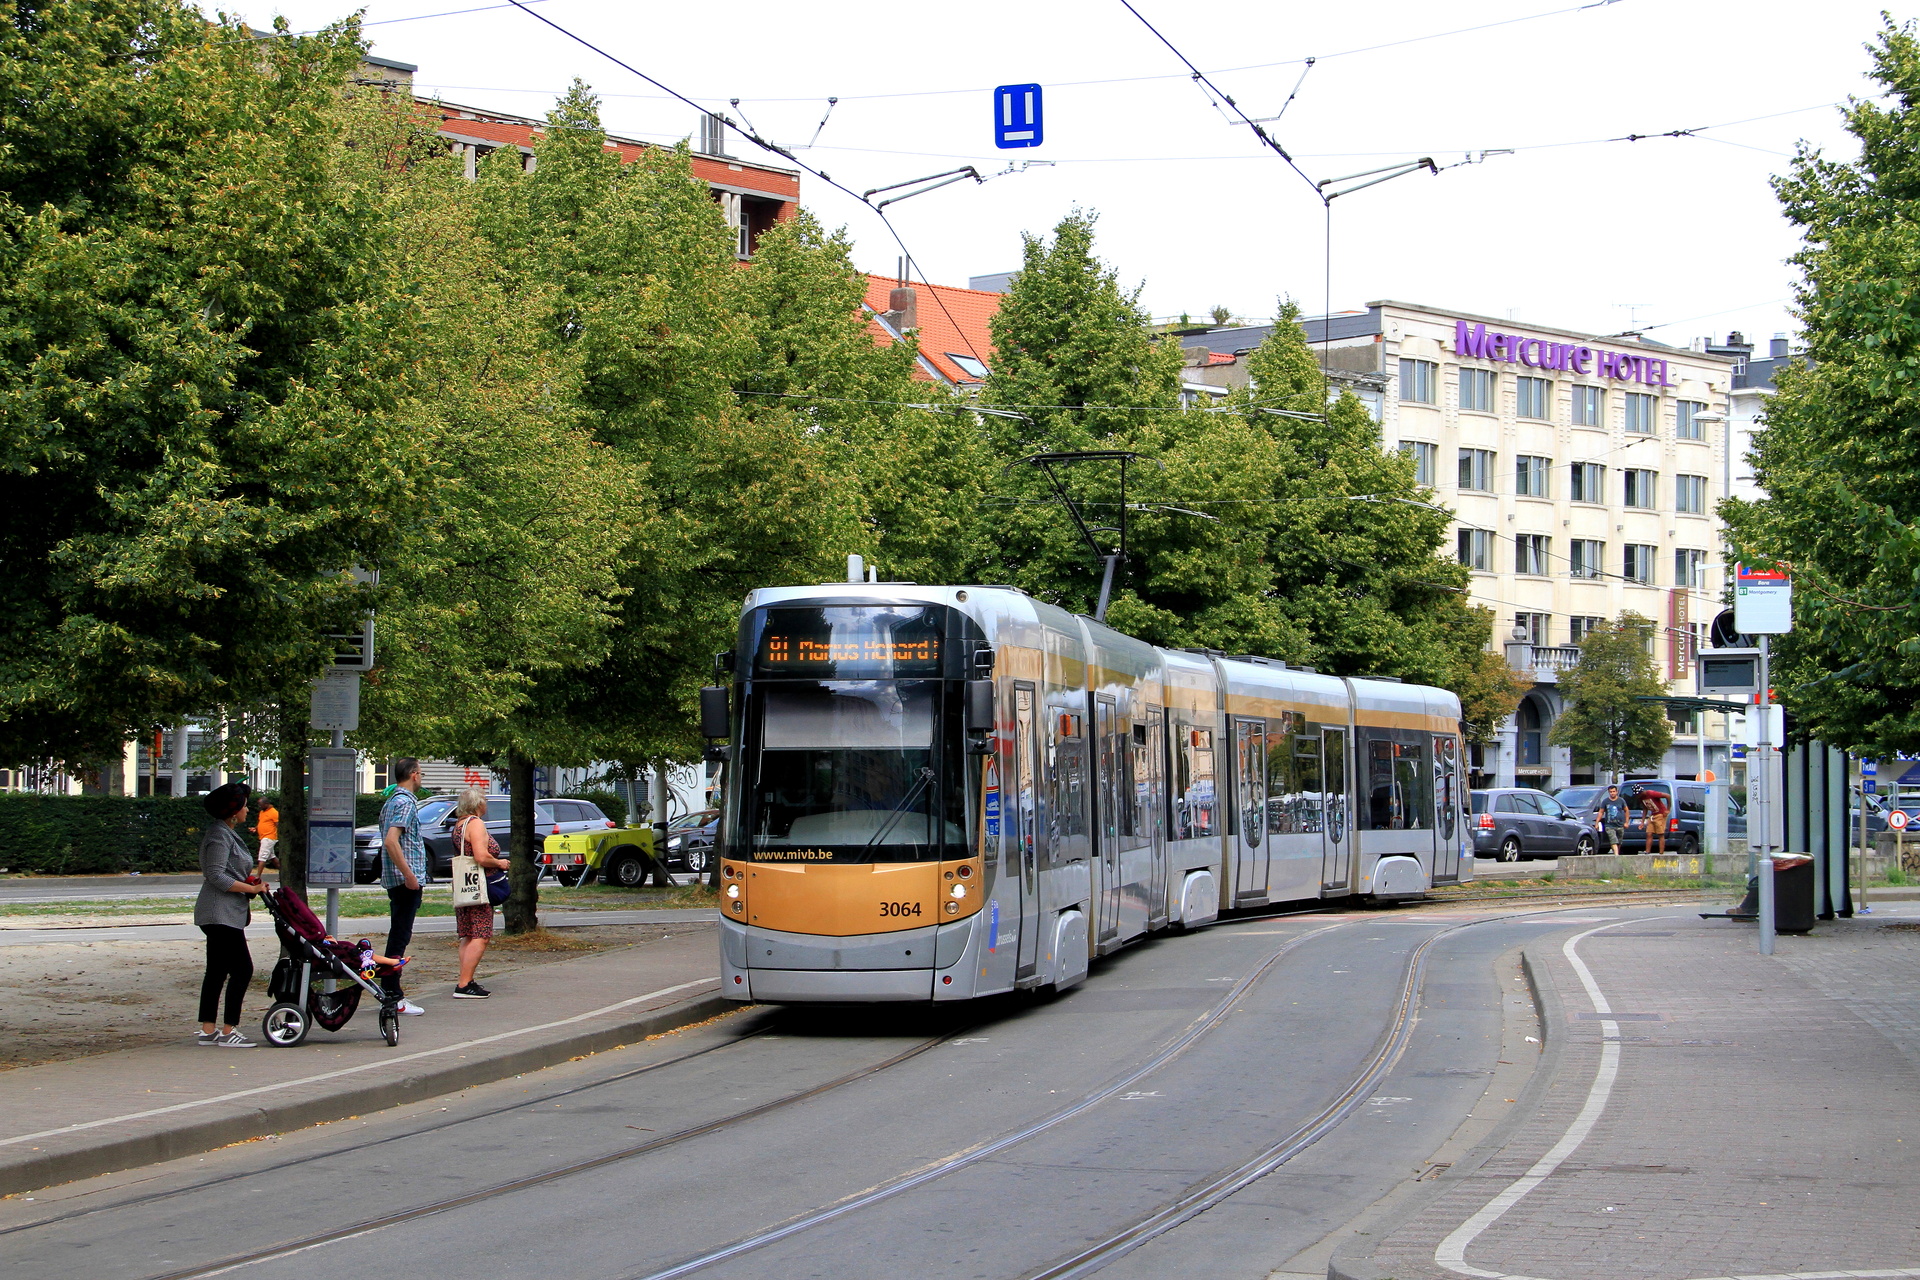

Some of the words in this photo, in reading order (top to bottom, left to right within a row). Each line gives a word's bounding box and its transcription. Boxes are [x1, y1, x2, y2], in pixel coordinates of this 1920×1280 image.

[1455, 320, 1593, 374] Mercure
[1597, 350, 1675, 387] HOTEL
[1677, 624, 1685, 672] Mercure
[753, 849, 833, 860] www.mivb.be
[879, 902, 922, 917] 3064
